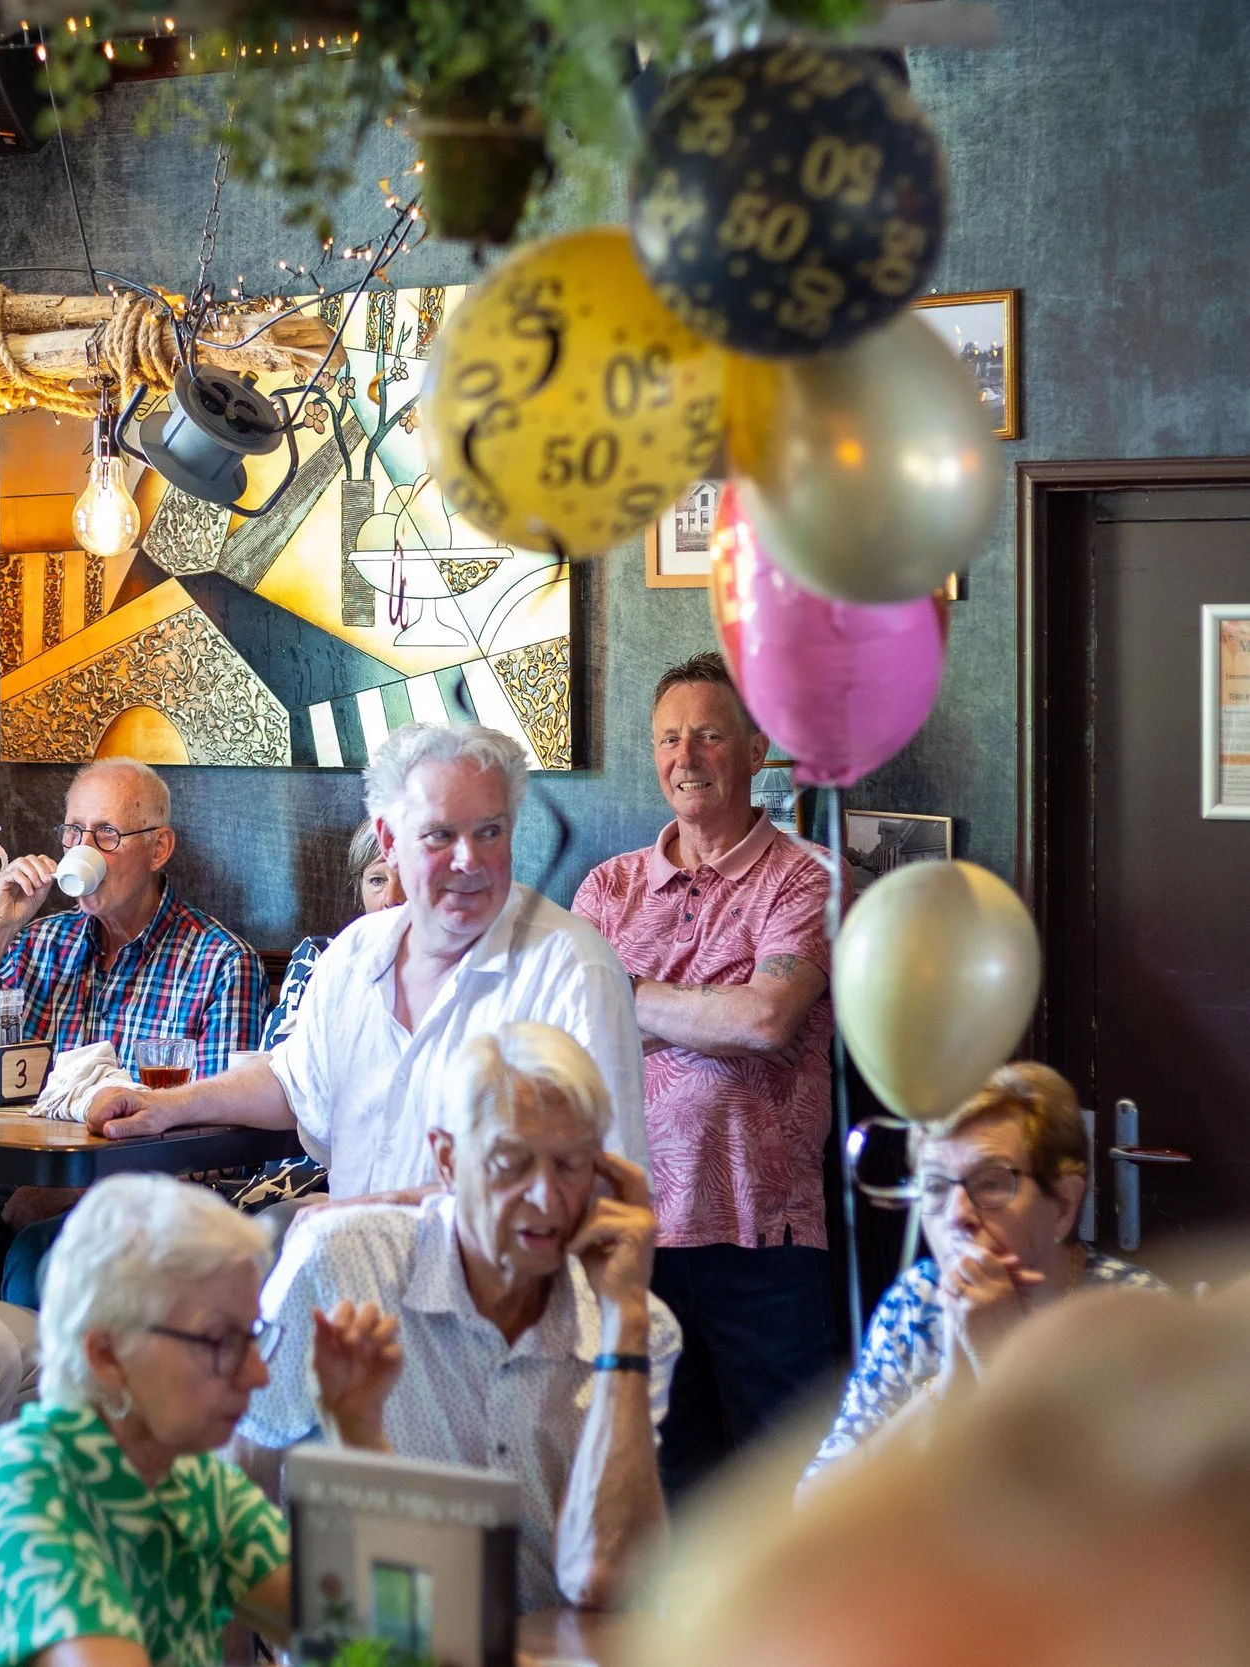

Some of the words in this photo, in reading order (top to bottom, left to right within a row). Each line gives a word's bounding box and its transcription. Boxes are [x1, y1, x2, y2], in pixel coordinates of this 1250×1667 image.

[801, 135, 884, 206] 50
[718, 193, 810, 262] 50
[604, 343, 674, 419] 50
[539, 430, 621, 490] 50
[14, 1058, 27, 1089] 3
